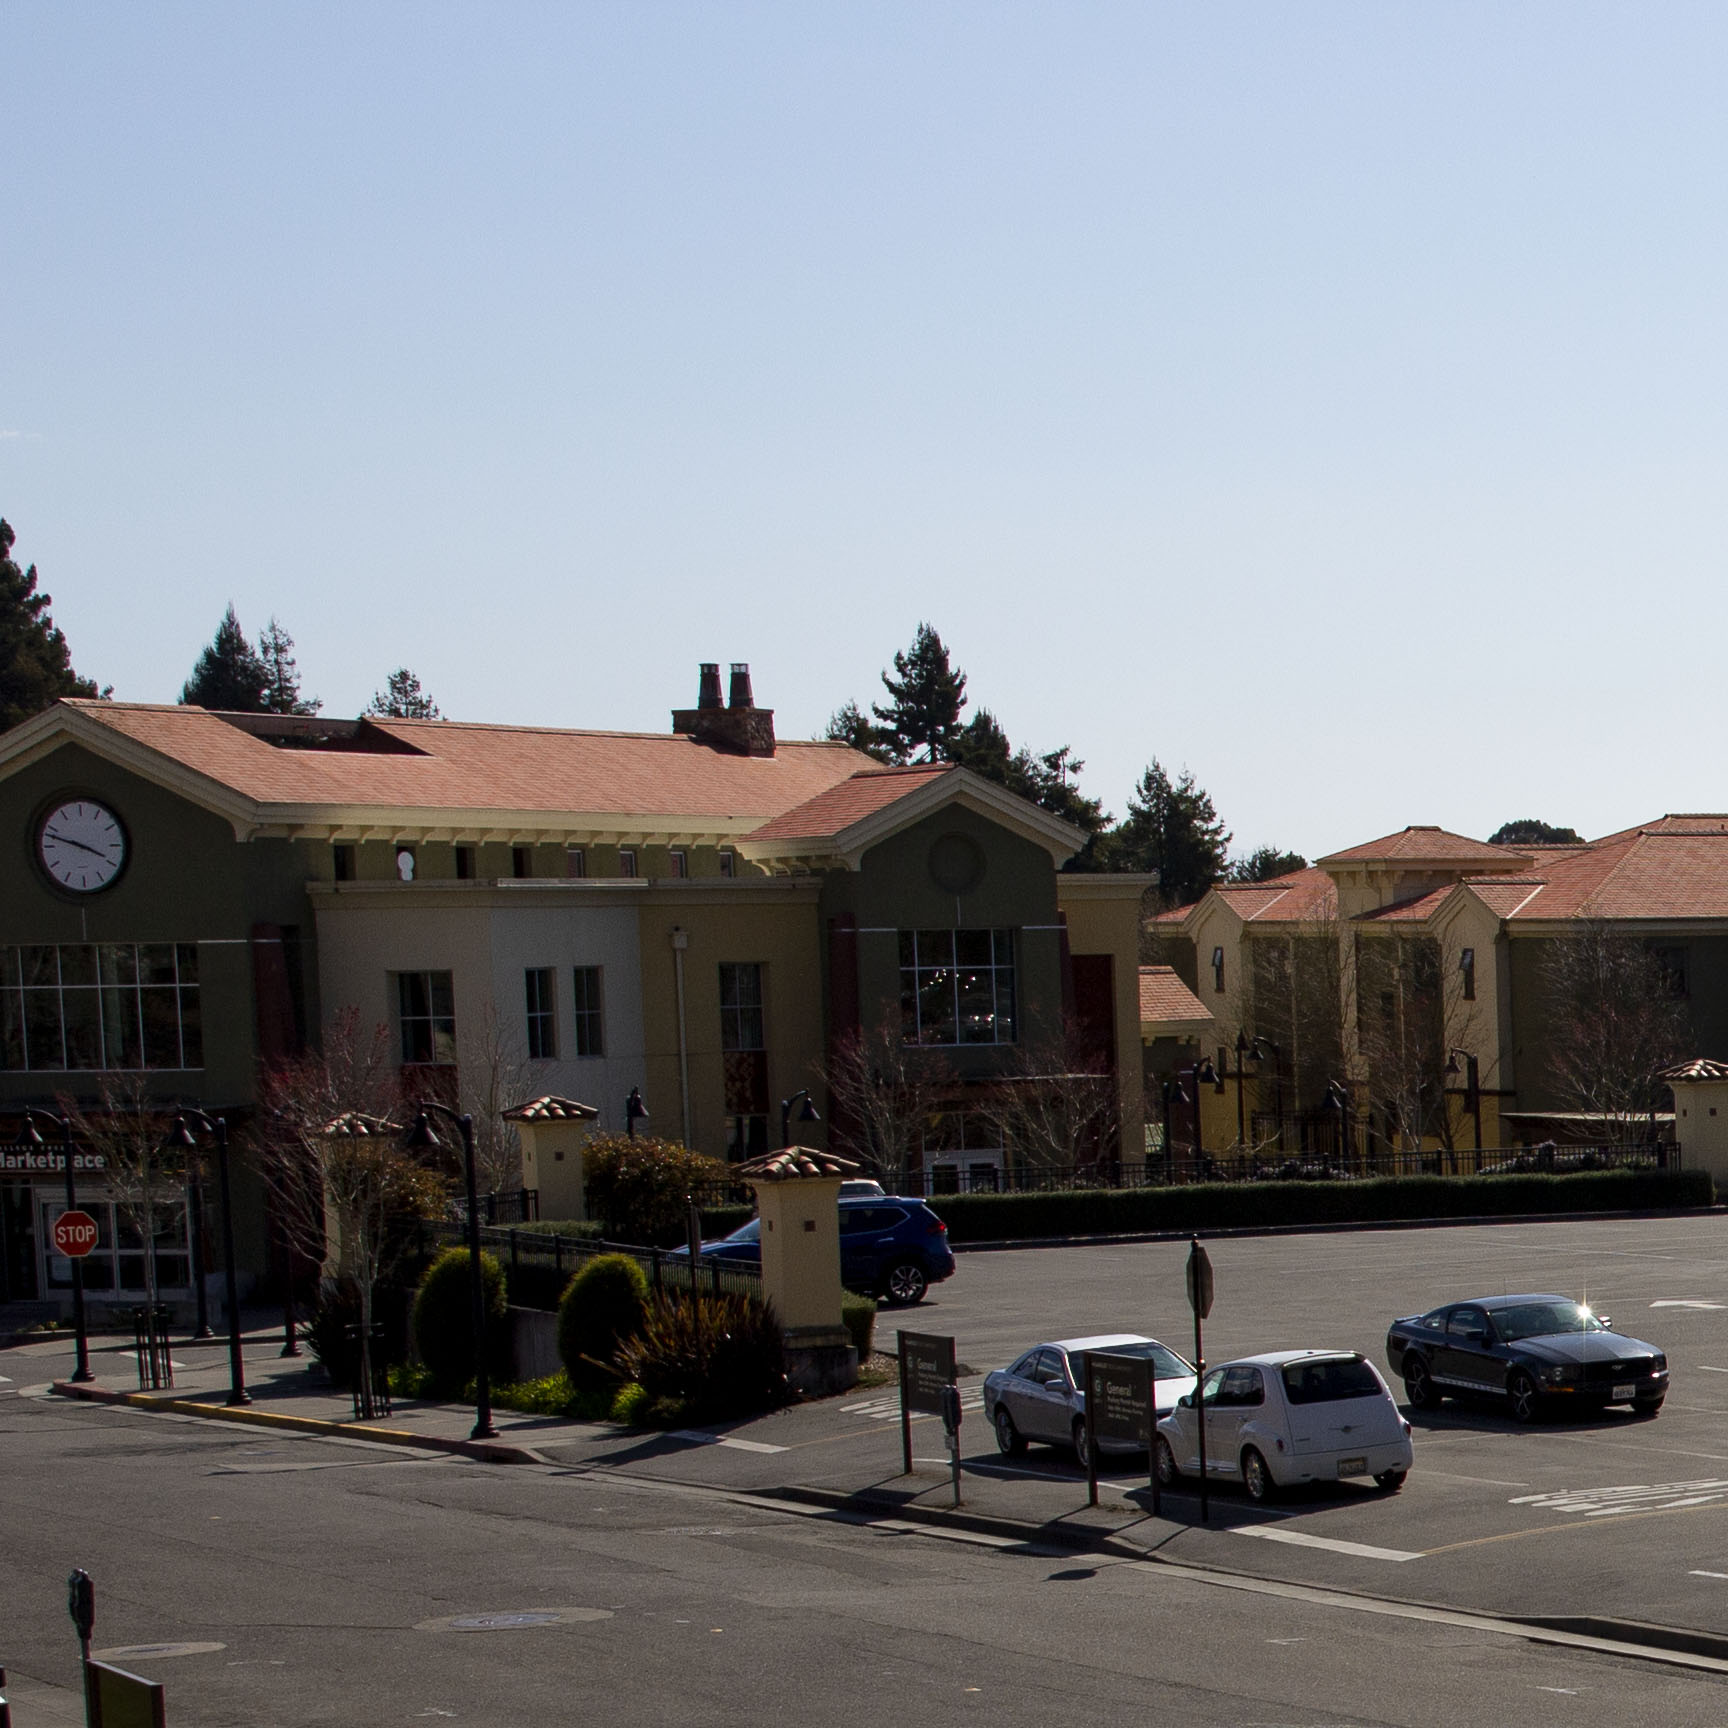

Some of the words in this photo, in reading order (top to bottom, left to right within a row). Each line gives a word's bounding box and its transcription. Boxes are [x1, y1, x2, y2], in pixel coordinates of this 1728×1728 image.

[0, 1151, 105, 1171] arketpace
[57, 1225, 96, 1244] STOP
[1106, 1381, 1132, 1397] General
